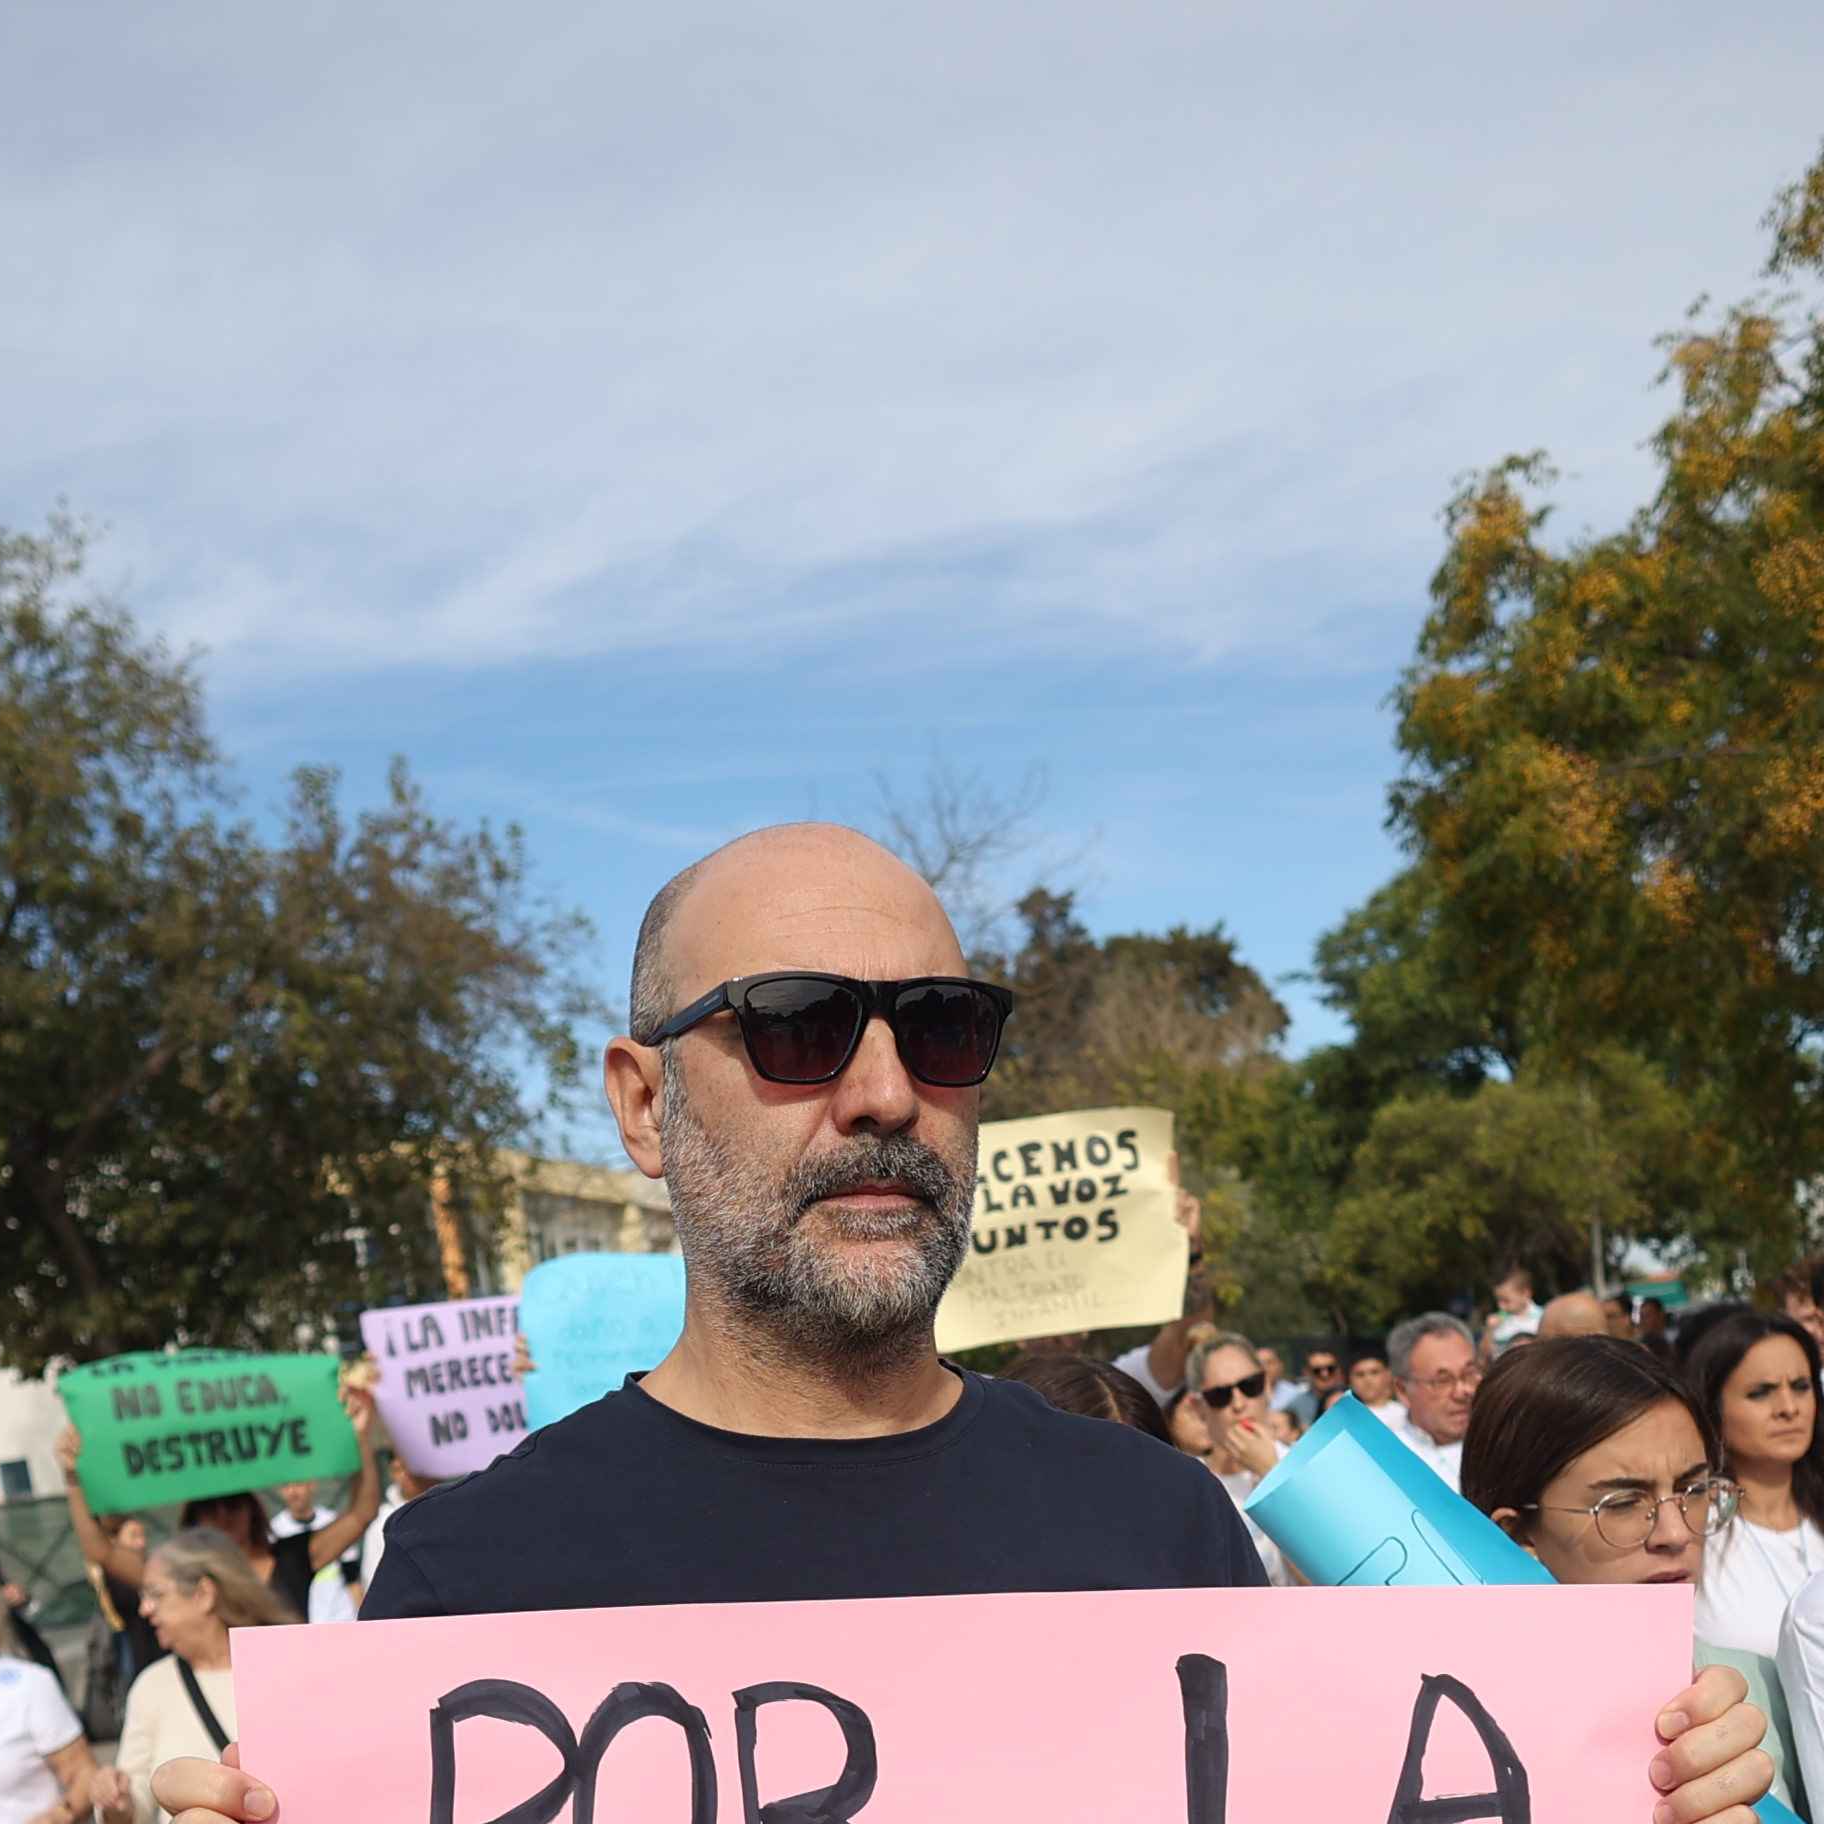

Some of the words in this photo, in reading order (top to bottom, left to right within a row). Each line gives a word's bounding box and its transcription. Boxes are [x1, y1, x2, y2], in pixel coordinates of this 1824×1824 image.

[977, 1129, 1139, 1184] CEMOS
[983, 1184, 1037, 1213] LA
[1049, 1174, 1128, 1206] VOZ
[404, 1352, 514, 1400] MERECE
[110, 1384, 162, 1422] NO
[121, 1417, 312, 1477] DESTRUYE
[429, 1408, 468, 1448] NO
